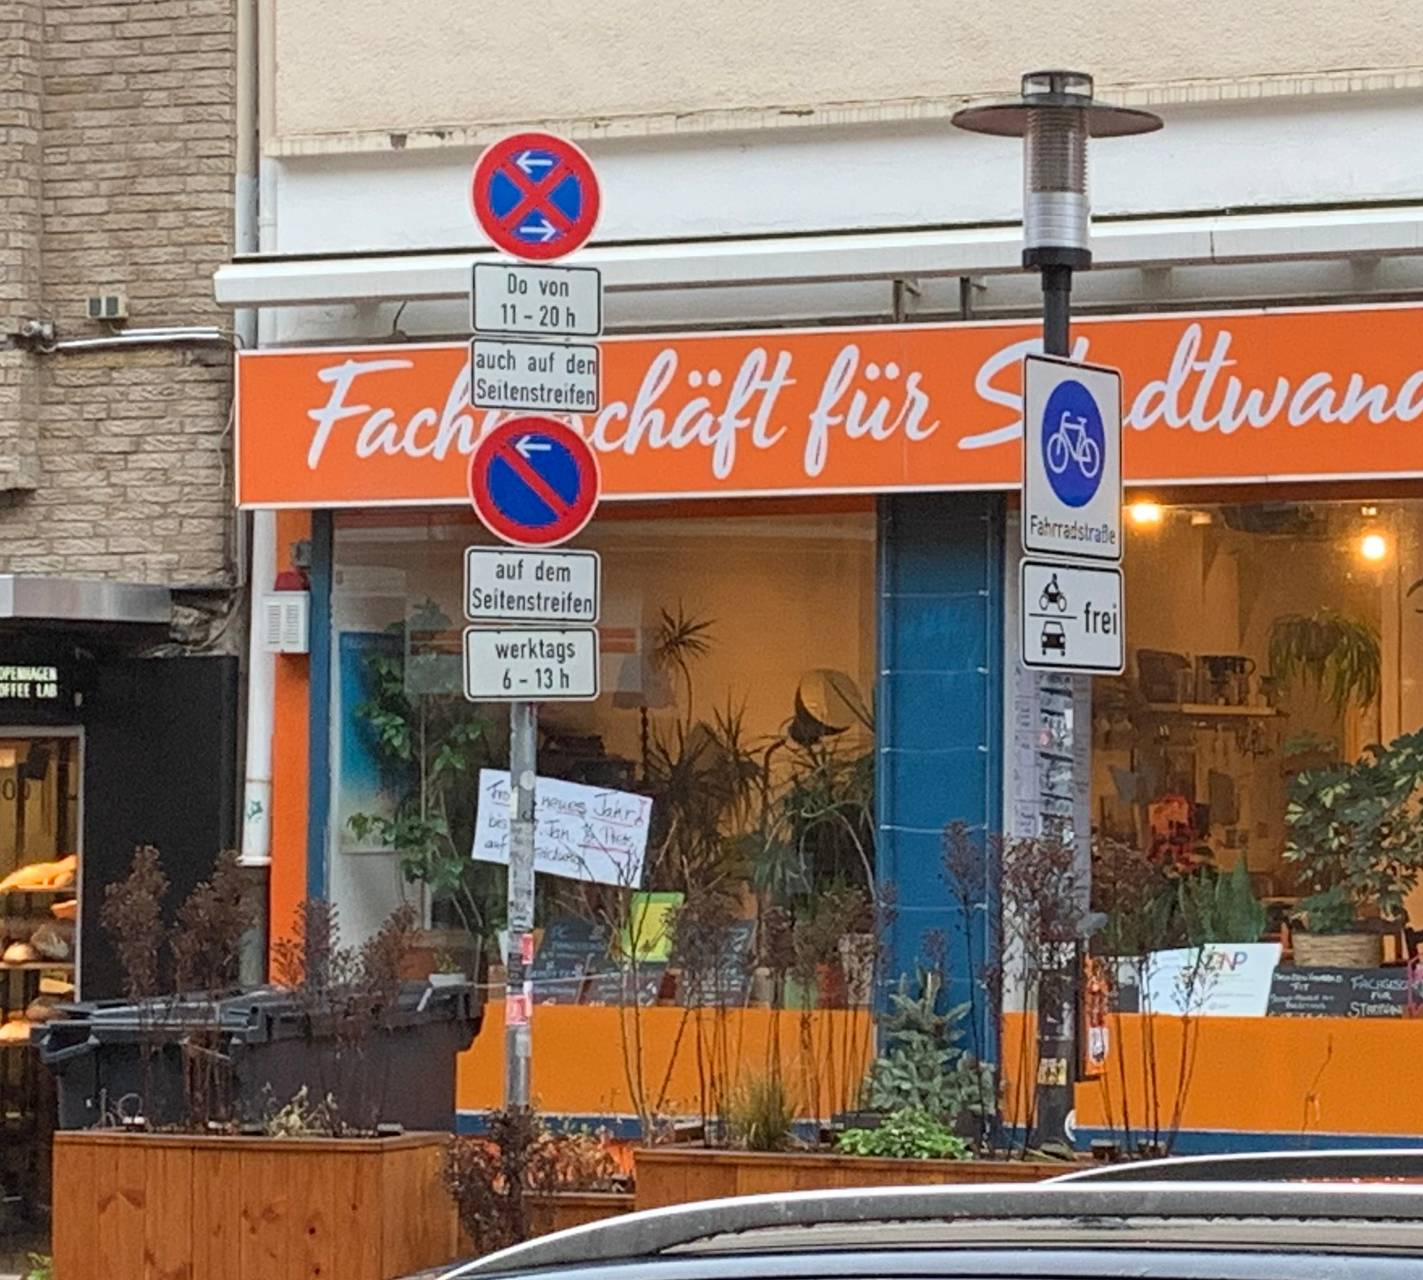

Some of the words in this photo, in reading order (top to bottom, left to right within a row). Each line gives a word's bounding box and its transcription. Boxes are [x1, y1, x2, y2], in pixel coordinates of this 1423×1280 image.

[508, 273, 527, 294] Do
[539, 280, 569, 297] von
[501, 303, 516, 324] 11
[539, 305, 559, 327] 20
[566, 307, 576, 328] h
[476, 349, 516, 370] auch
[528, 352, 556, 373] auf
[566, 354, 597, 375] den
[476, 378, 595, 405] Seitenstreifen
[306, 345, 796, 480] Fachchäft
[804, 343, 940, 477] für
[1029, 515, 1116, 545] Fahrradstraße
[496, 559, 524, 580] auf
[535, 560, 571, 582] dem
[472, 588, 592, 613] Seitenstreifen
[1083, 601, 1118, 635] frei
[495, 637, 576, 664] werktags
[36, 683, 58, 698] LAB
[503, 668, 512, 690] 6
[535, 668, 553, 689] 13
[560, 668, 570, 689] h
